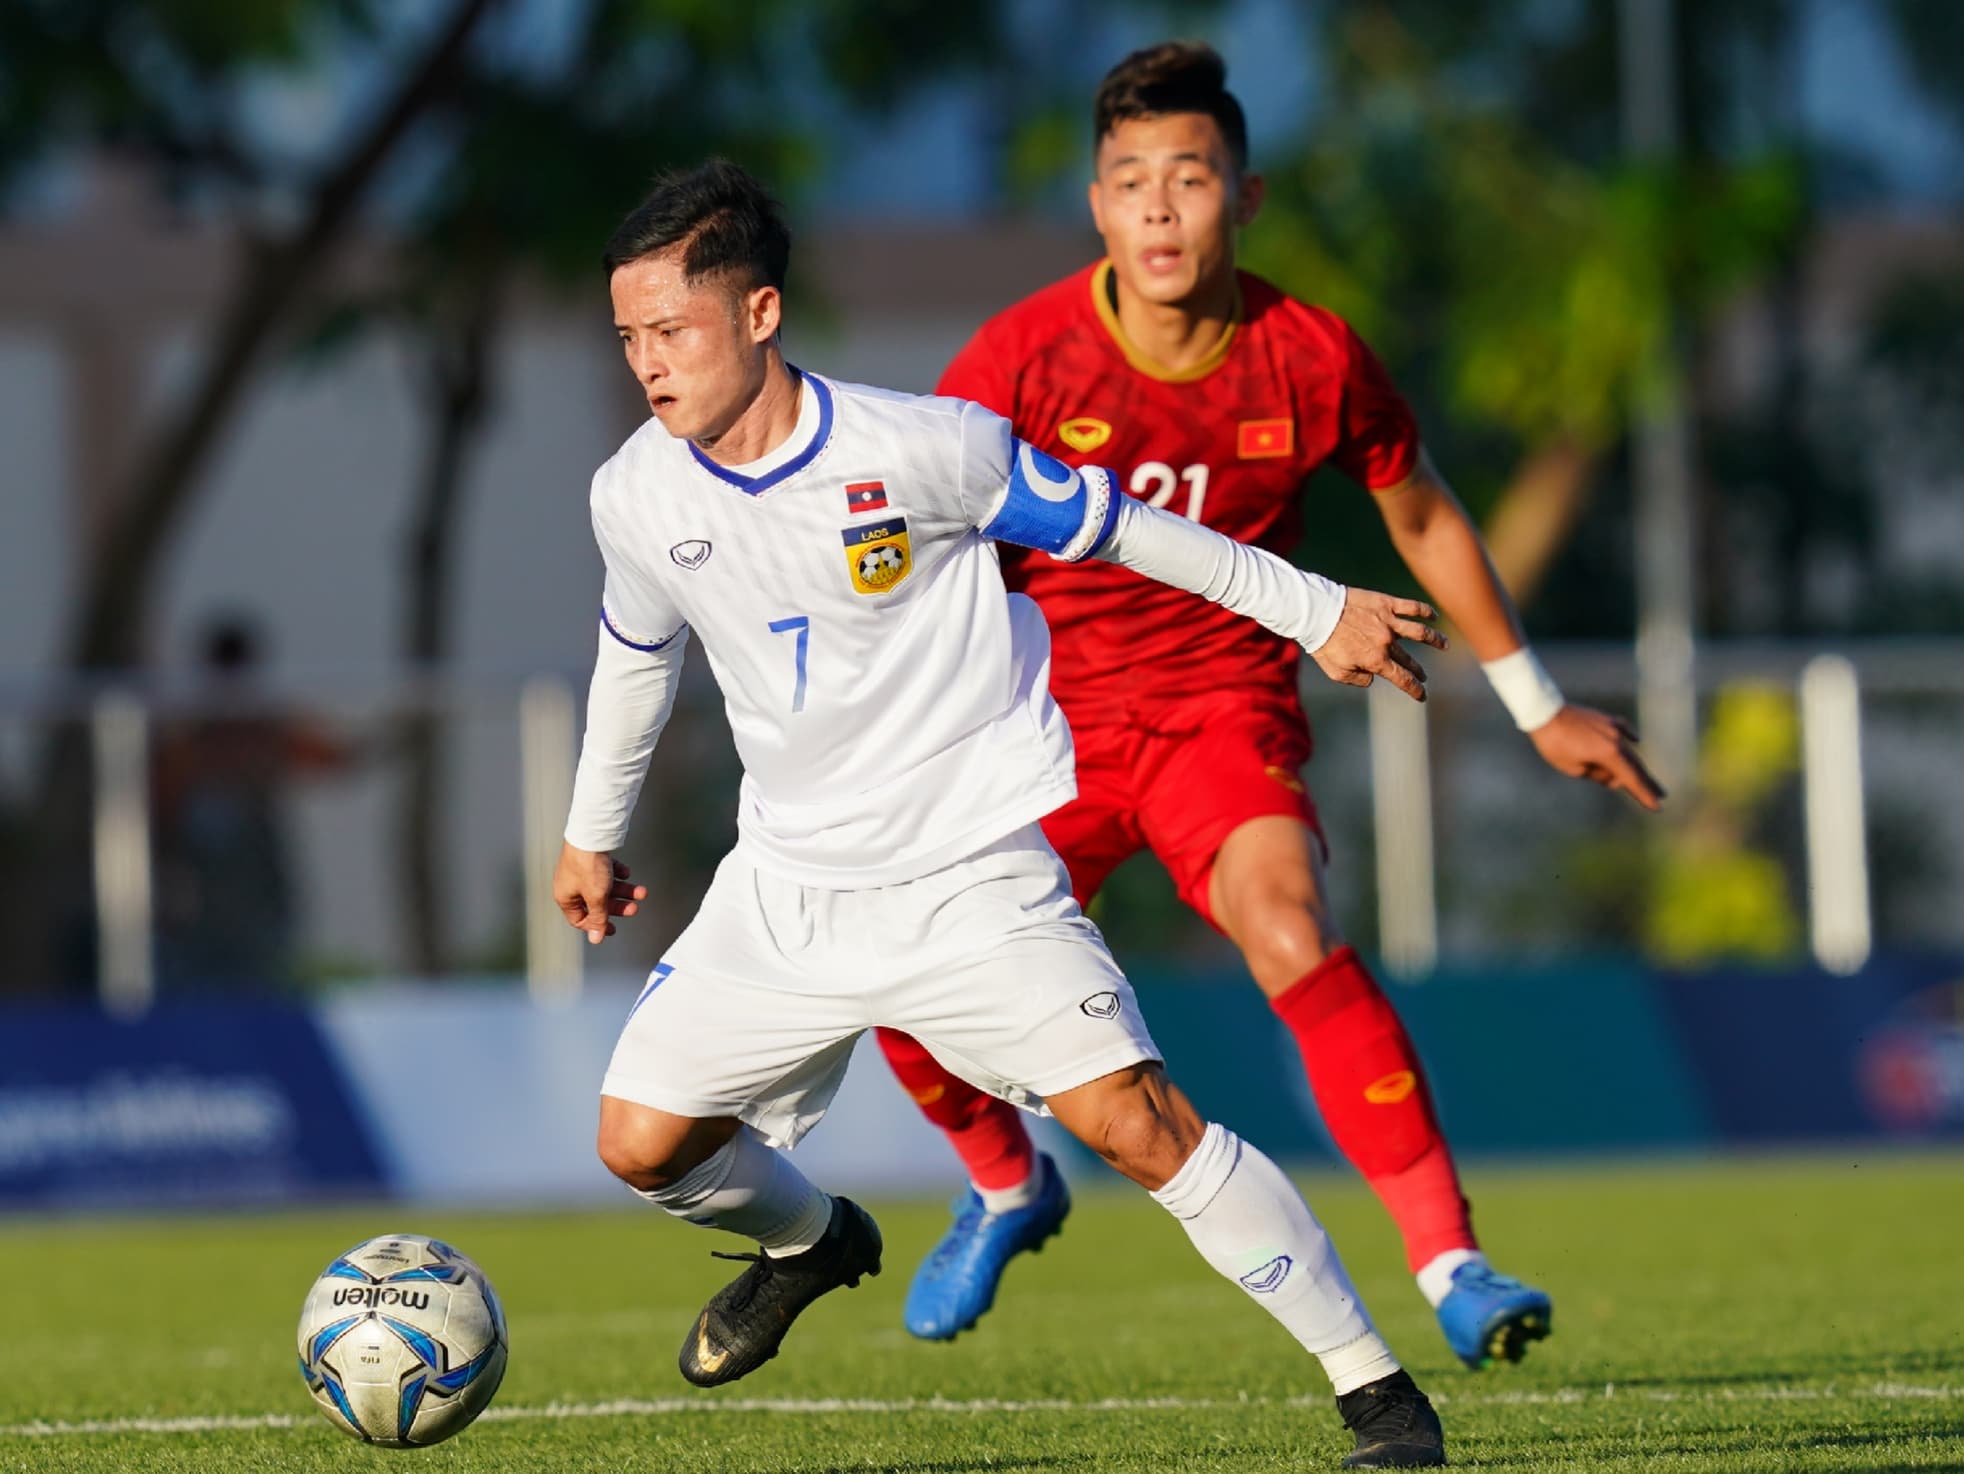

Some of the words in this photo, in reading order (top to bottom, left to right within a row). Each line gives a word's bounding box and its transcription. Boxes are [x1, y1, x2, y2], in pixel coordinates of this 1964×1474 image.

[1129, 461, 1210, 523] 21
[861, 528, 889, 541] LAOS
[768, 616, 809, 713] 7
[333, 1287, 430, 1310] molten
[360, 1355, 381, 1364] FIFA
